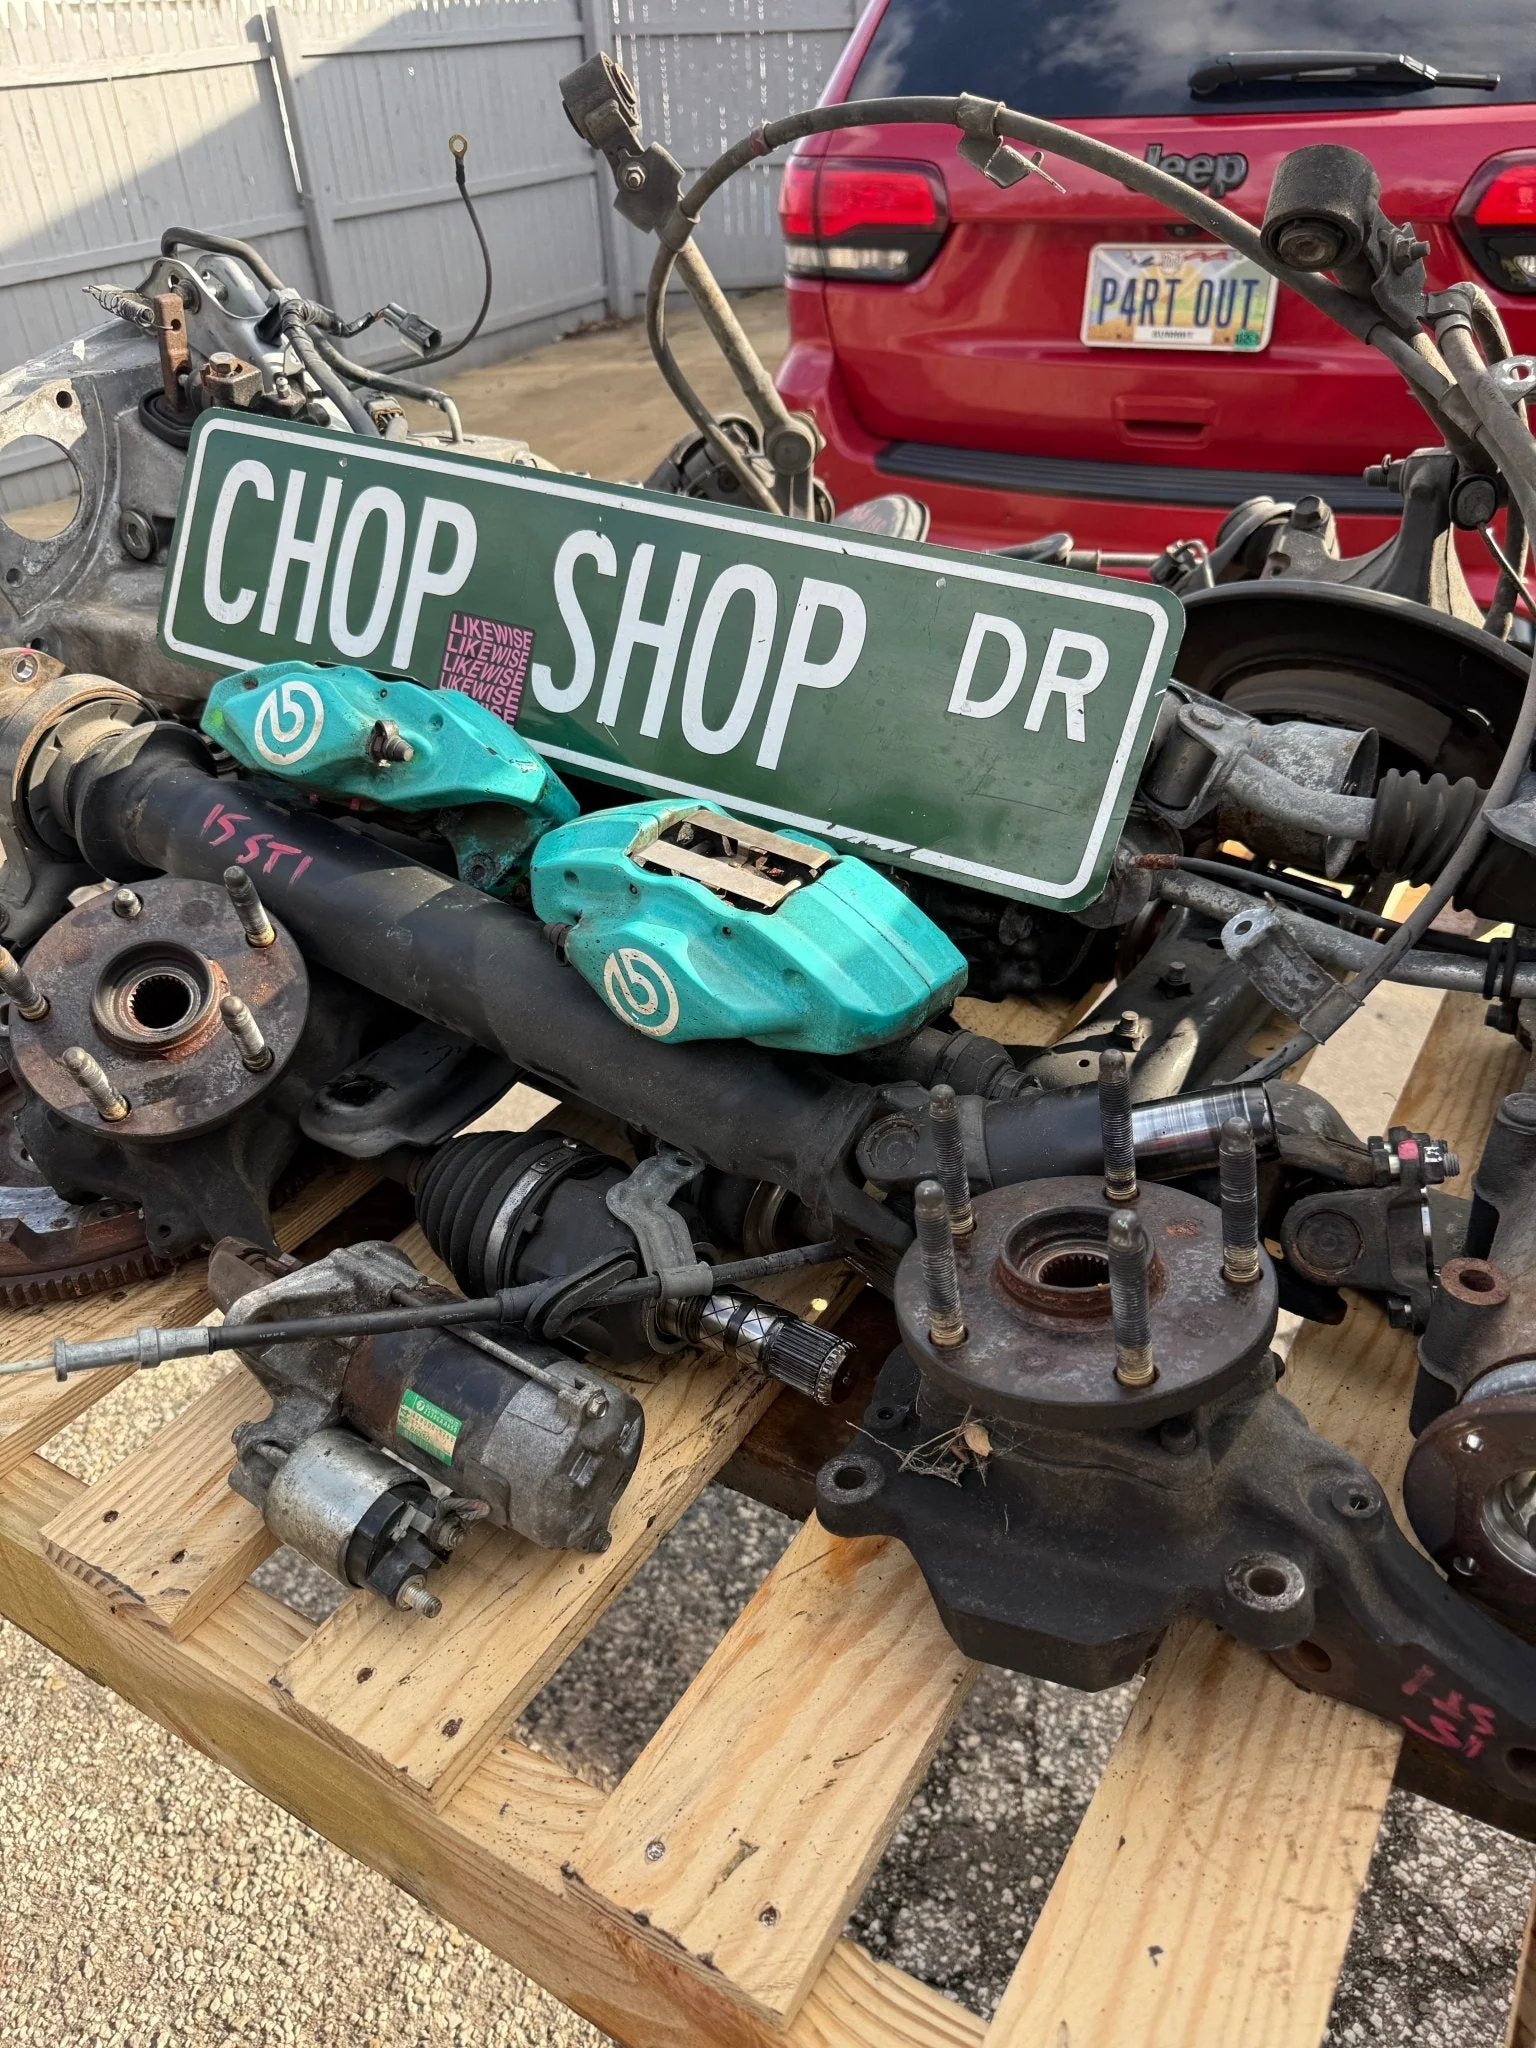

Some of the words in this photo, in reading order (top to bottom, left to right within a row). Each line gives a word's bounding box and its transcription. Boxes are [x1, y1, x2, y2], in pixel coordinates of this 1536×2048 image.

[1098, 277, 1181, 326] P4RT
[1194, 279, 1259, 328] OUT
[203, 459, 478, 670] CHOP
[531, 529, 867, 771] SHOP
[947, 612, 1110, 743] DR
[450, 613, 534, 651] LIKEWISE
[446, 633, 529, 671] LIKEWISE
[442, 652, 526, 691] LIKEWISE
[439, 672, 521, 710] LIKEWISE
